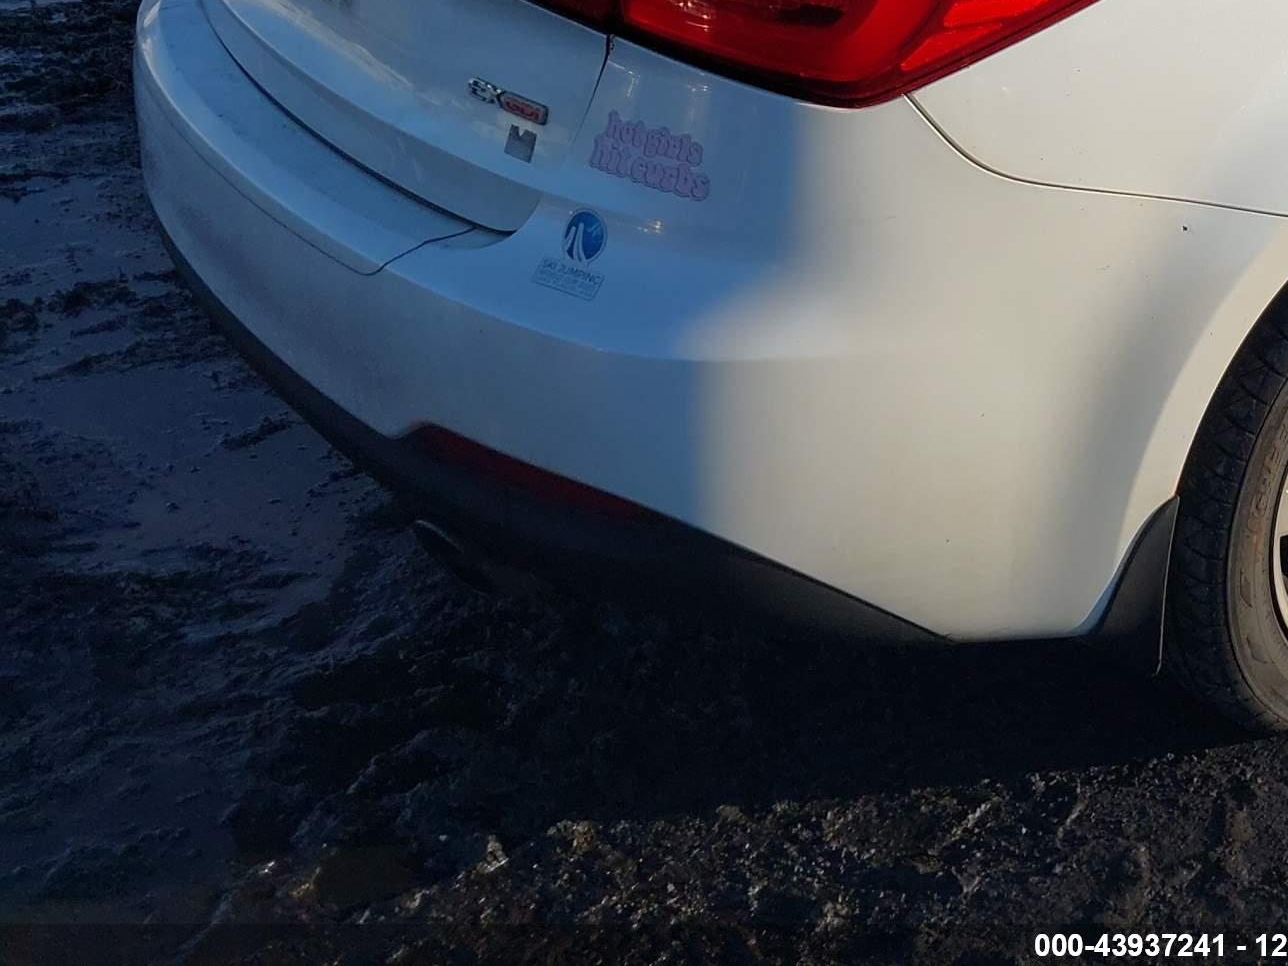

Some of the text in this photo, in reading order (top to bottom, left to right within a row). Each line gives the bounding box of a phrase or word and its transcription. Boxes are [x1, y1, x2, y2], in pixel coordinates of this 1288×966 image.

[468, 76, 501, 104] EX
[606, 109, 703, 166] hot girls
[590, 135, 710, 201] hit curbs
[559, 264, 603, 285] JUMPING
